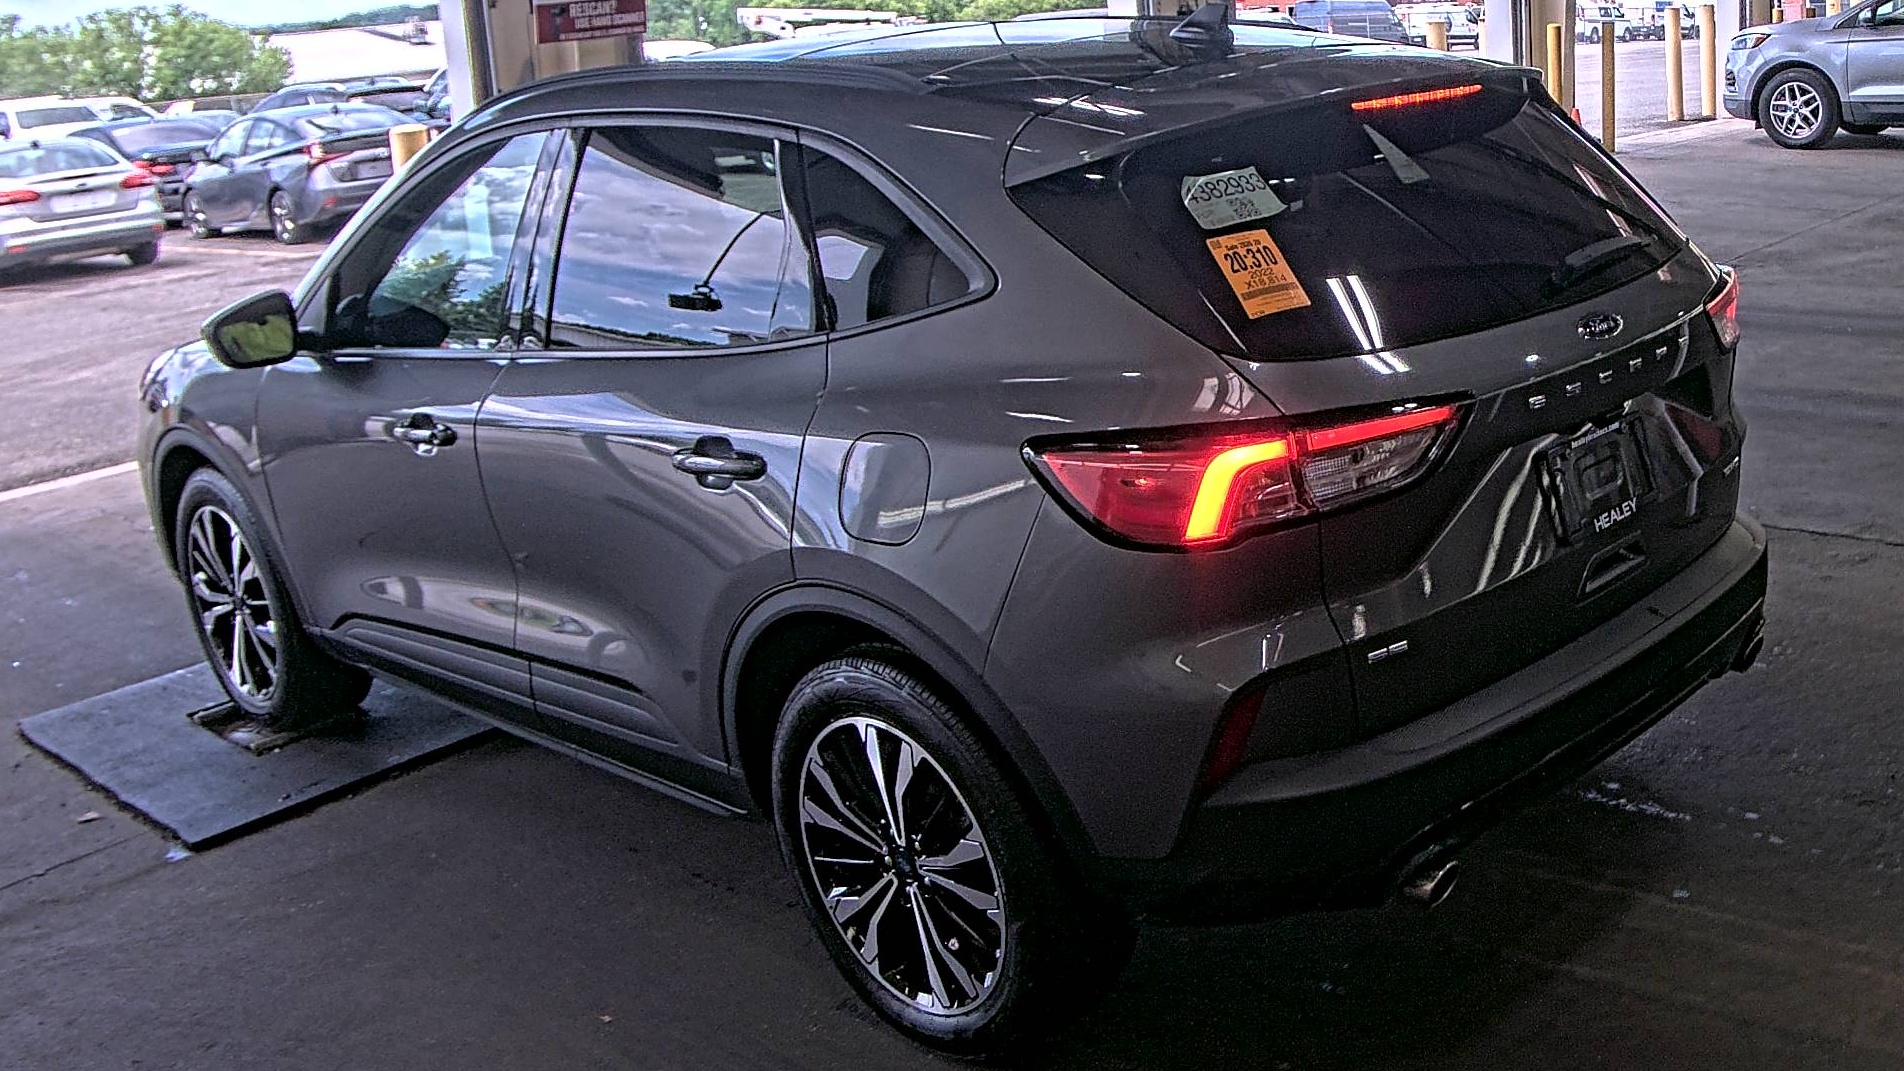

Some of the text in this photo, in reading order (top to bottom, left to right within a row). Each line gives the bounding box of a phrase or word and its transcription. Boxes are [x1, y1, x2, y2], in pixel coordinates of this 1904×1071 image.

[1185, 173, 1267, 204] 4382933
[1224, 245, 1279, 274] 20:310
[1248, 268, 1275, 280] 2022
[1594, 496, 1637, 533] HEALEY
